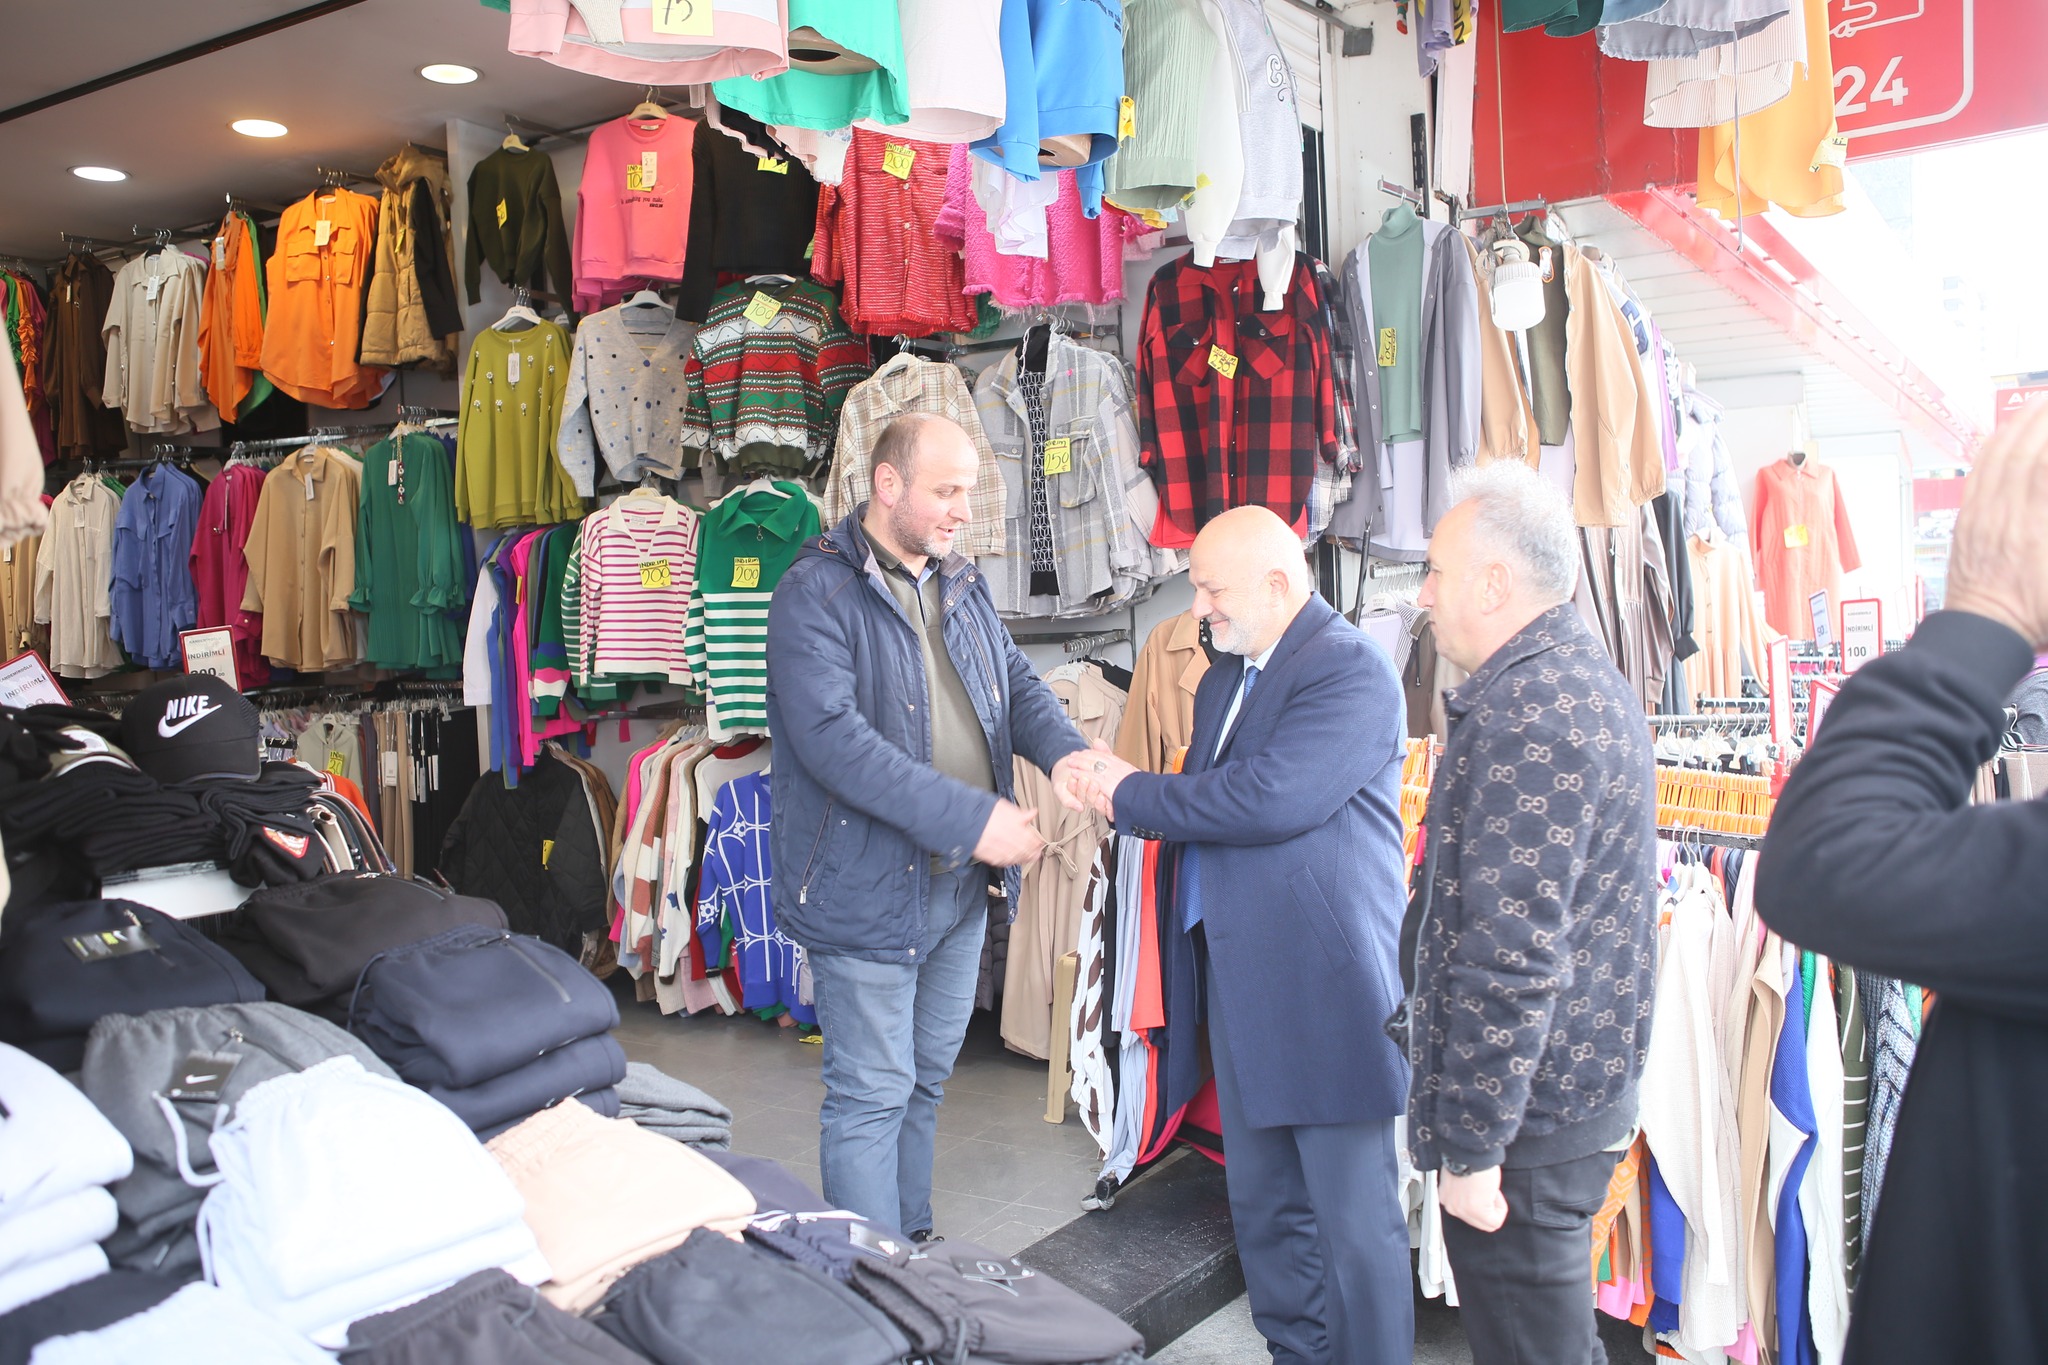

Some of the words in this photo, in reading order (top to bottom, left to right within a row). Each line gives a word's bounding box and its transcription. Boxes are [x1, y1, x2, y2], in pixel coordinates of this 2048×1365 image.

[886, 152, 910, 169] 200
[750, 303, 774, 320] 100
[1045, 452, 1070, 472] 250
[641, 567, 671, 586] 200
[736, 566, 759, 582] 200
[1848, 646, 1867, 657] 100
[165, 694, 210, 720] NIKE
